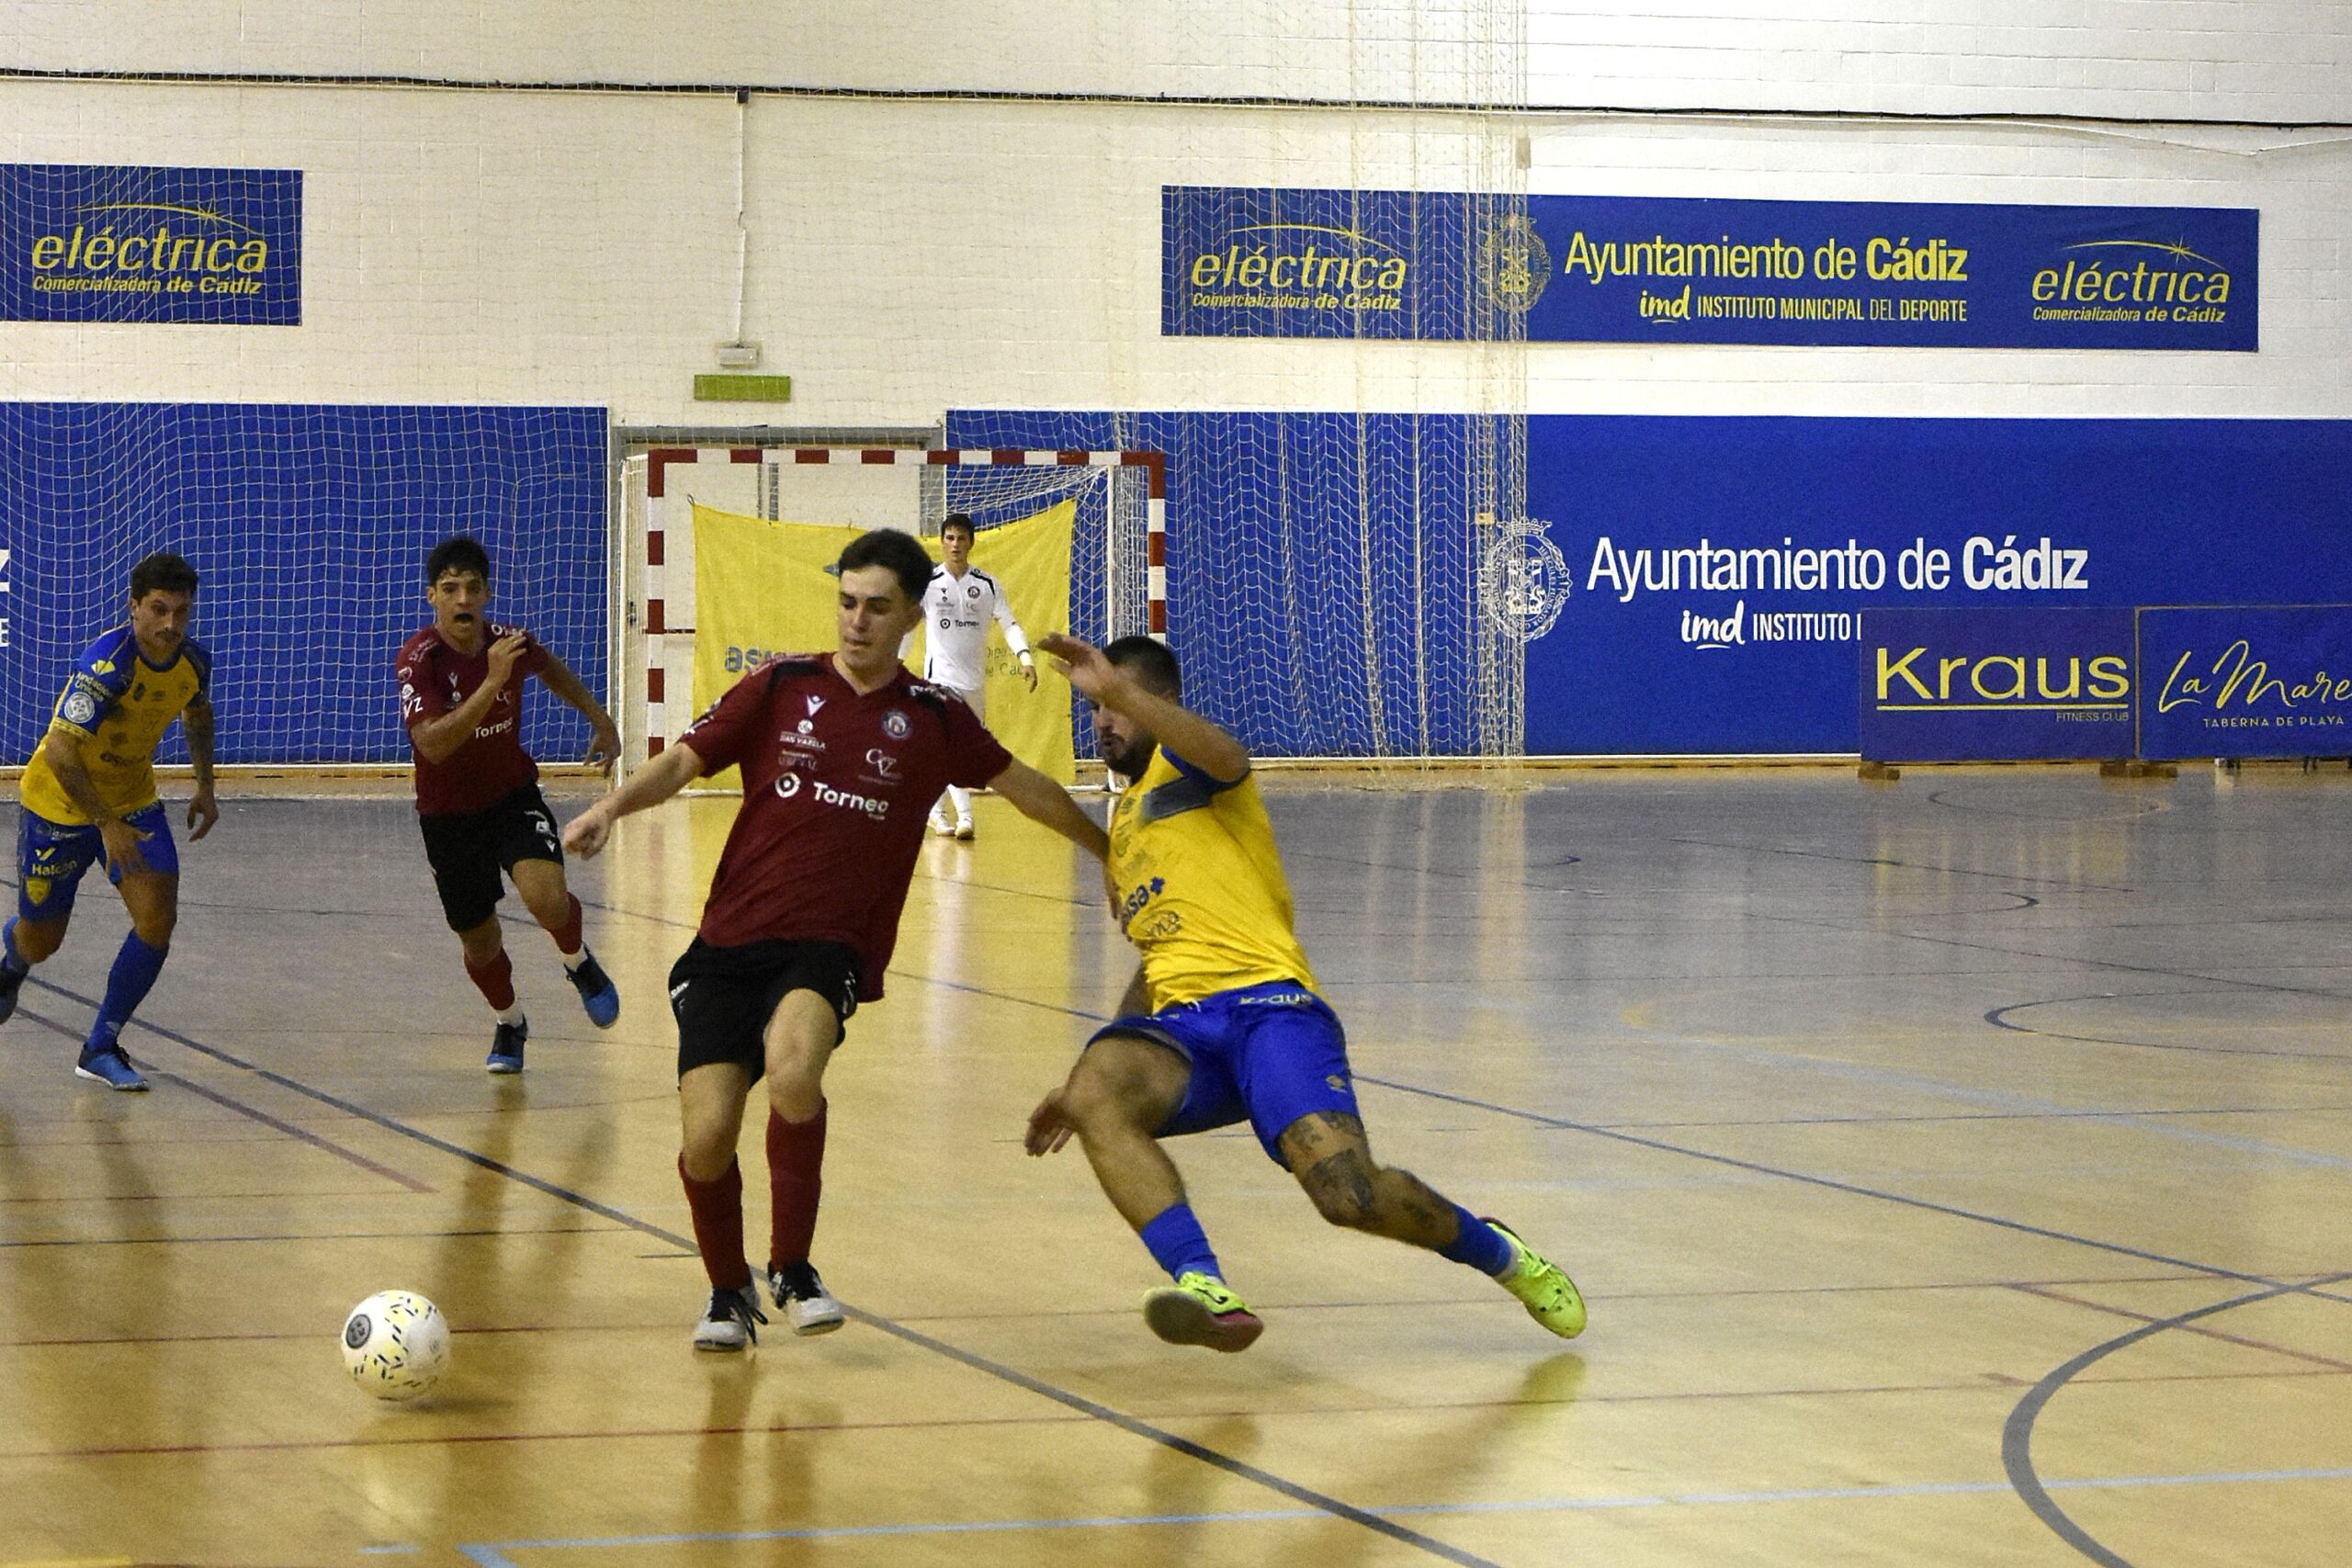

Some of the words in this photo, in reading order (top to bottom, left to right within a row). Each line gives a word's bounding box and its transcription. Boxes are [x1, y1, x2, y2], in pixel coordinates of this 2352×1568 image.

[31, 226, 268, 273] eléctrica
[1192, 245, 1407, 290] eléctrica
[1565, 231, 1804, 284] Ayuntamiento
[1814, 237, 1857, 280] de
[1866, 236, 1968, 281] Cádiz
[33, 276, 160, 292] Comercializadora
[166, 276, 192, 293] de
[198, 276, 263, 294] Cádiz
[1193, 293, 1310, 309] Comercializadora
[1314, 293, 1337, 309] de
[1344, 293, 1401, 310] Cádiz
[1640, 284, 1690, 321] imd
[1697, 296, 1775, 320] INSTITUTO
[1781, 298, 1864, 321] MUNICIPAL
[1870, 299, 1895, 321] DEL
[1899, 299, 1967, 321] DEPORTE
[2031, 260, 2231, 303] eléctrica
[2033, 306, 2140, 321] Comercializadora
[2145, 306, 2167, 321] de
[2172, 306, 2225, 322] Cádiz
[1586, 536, 1886, 602] Ayuntamiento
[1897, 536, 1950, 591] de
[1962, 535, 2088, 590] Cádiz
[1681, 600, 1745, 645] imd
[1753, 613, 1850, 641] INSTITUTO
[1876, 647, 2131, 700] Kraus
[2159, 650, 2211, 713] La
[2056, 711, 2099, 723] FITNESS
[2102, 711, 2130, 722] CLUB
[2203, 716, 2269, 728] TABERNA
[2276, 716, 2293, 727] DE
[2300, 715, 2344, 727] PLAYA
[813, 780, 889, 813] Torneo
